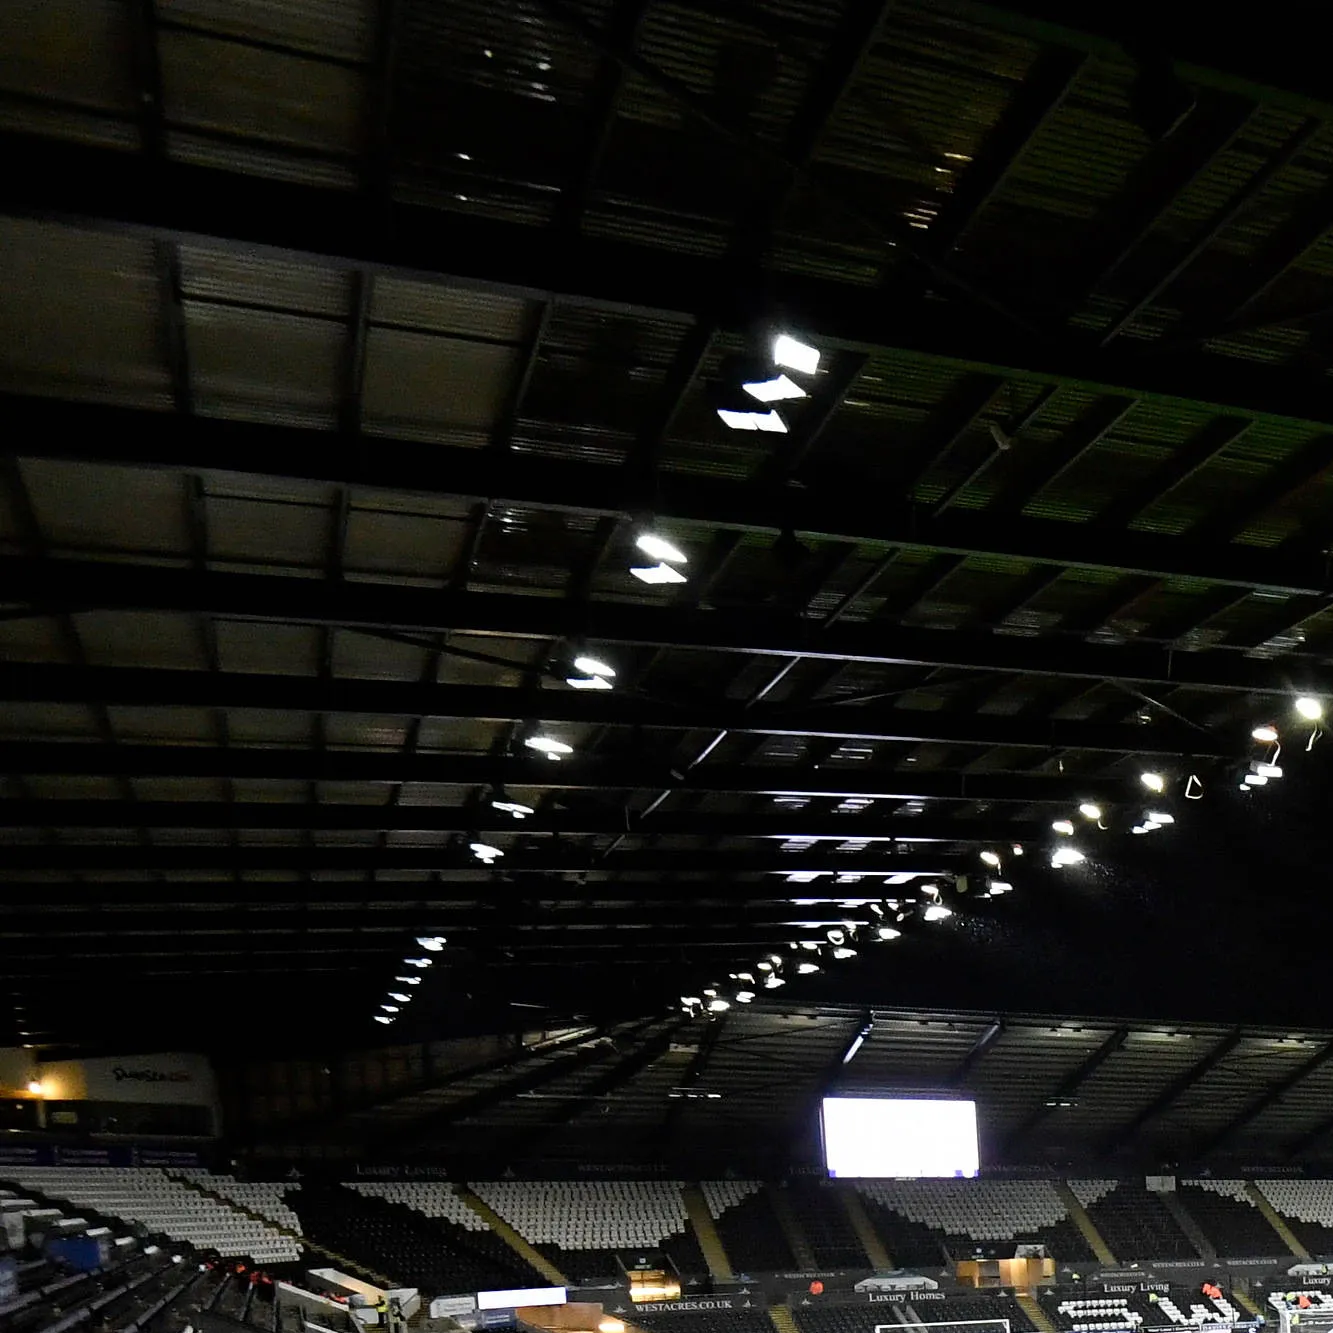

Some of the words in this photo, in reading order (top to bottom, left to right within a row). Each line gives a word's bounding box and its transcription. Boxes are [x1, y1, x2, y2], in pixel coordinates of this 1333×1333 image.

[1303, 1276, 1331, 1286] Luxury
[1104, 1283, 1138, 1294] Luxury
[1140, 1281, 1170, 1293] Living
[869, 1292, 905, 1303] Luxury
[910, 1290, 946, 1301] Homes
[635, 1300, 732, 1312] WESTACRES.CO.UK
